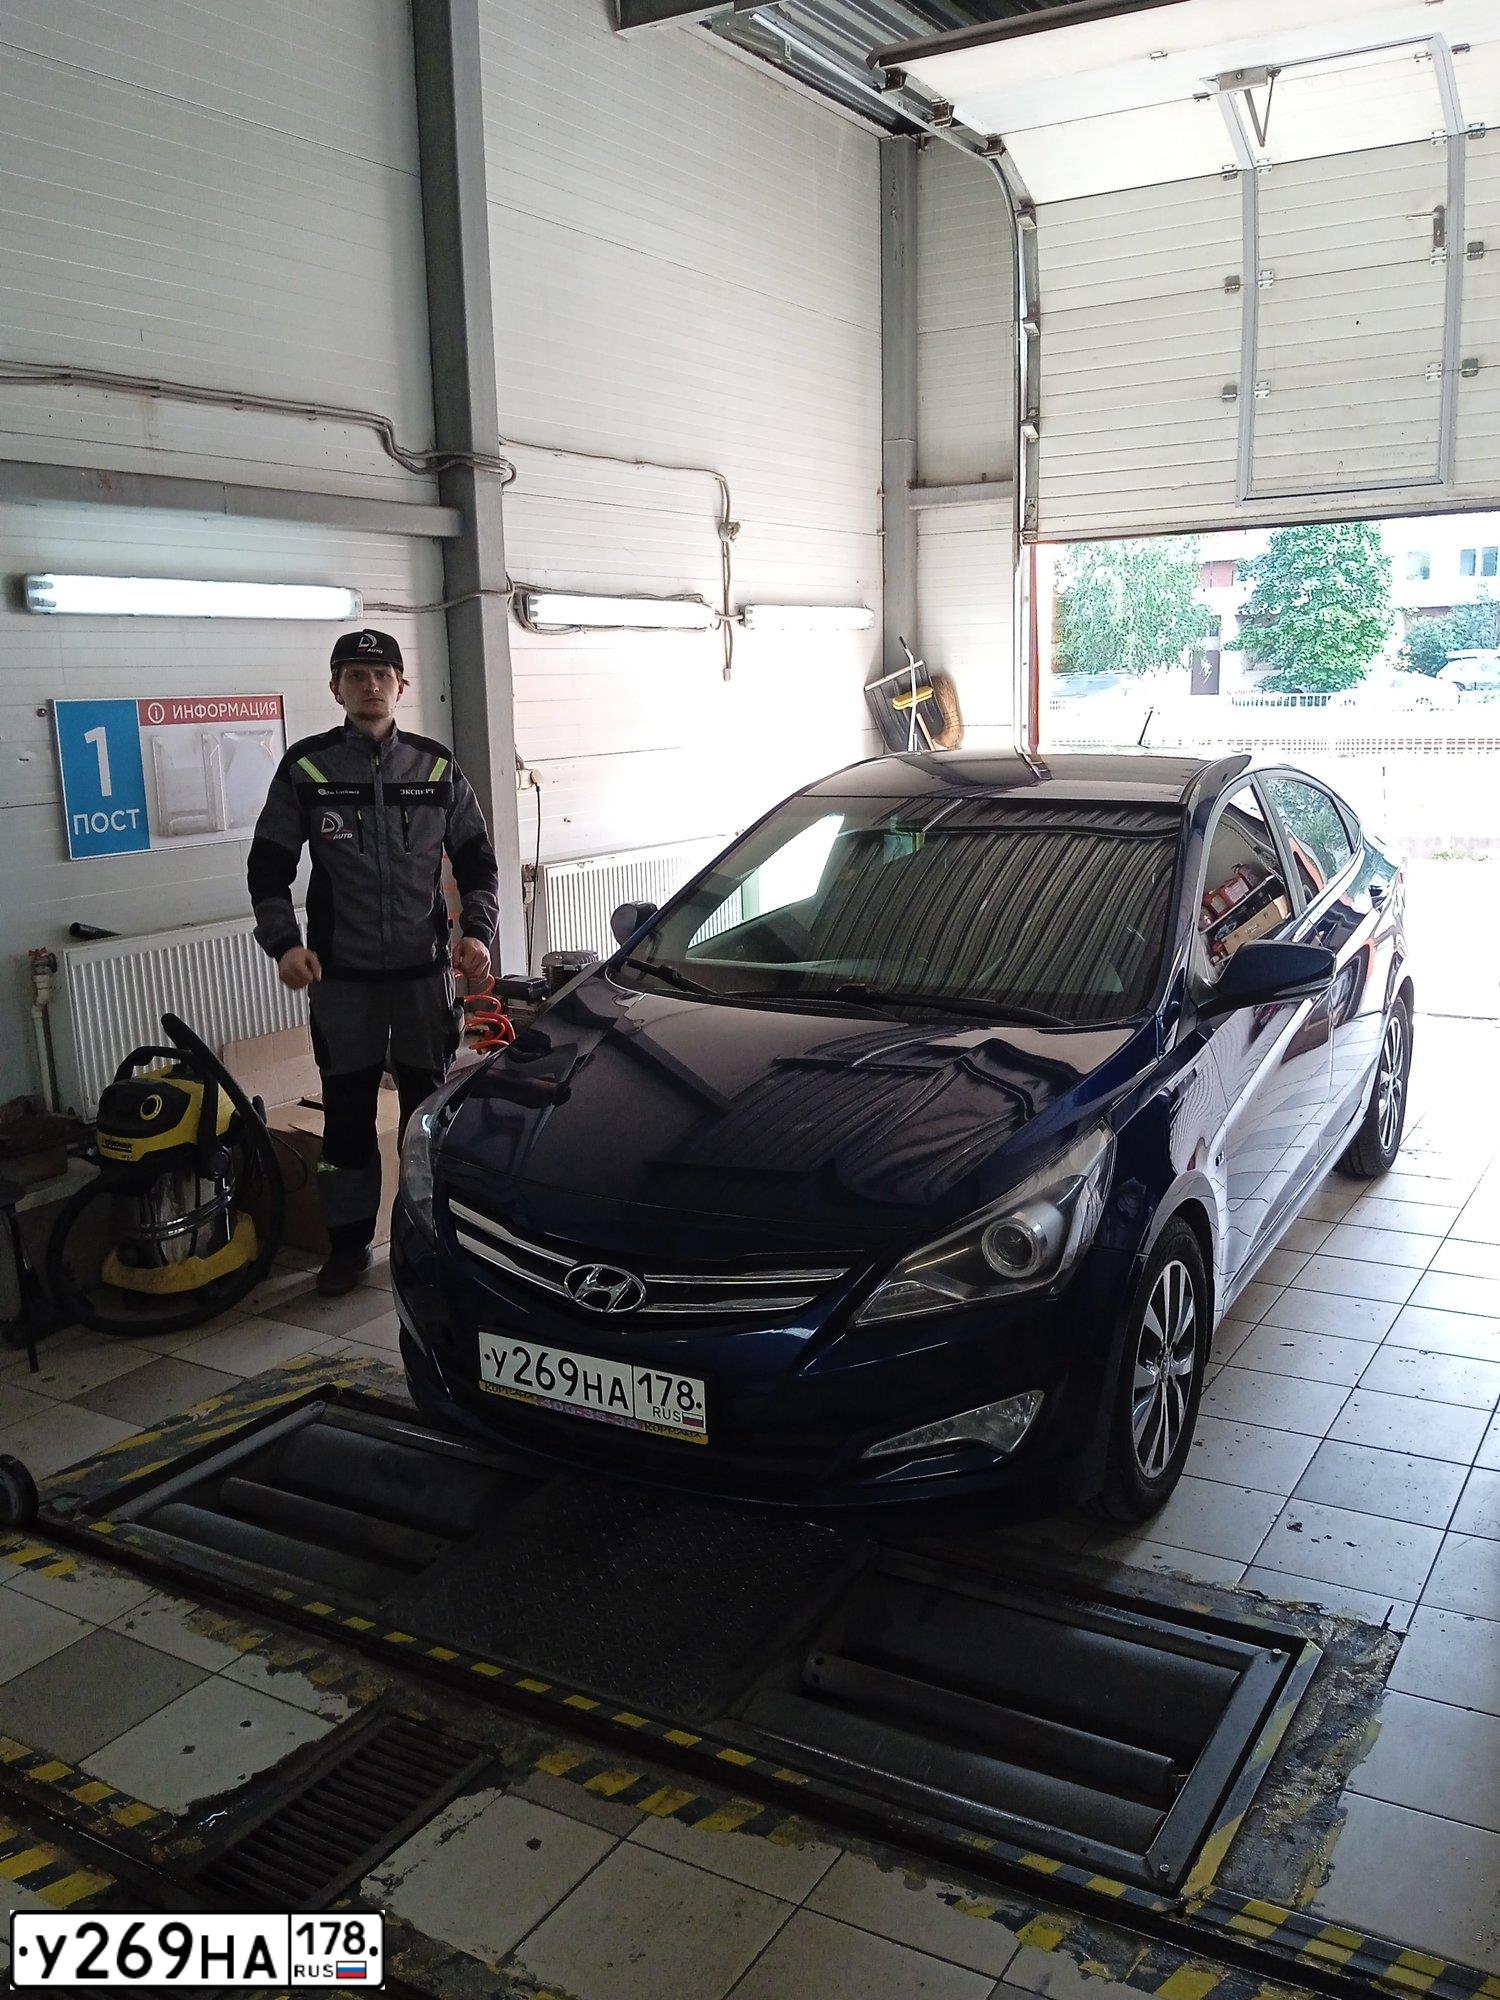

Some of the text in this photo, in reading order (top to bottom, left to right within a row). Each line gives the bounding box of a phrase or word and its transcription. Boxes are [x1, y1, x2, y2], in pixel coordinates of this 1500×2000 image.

[172, 701, 278, 719] ИНФОРМАЦИЯ
[83, 726, 112, 797] 1
[73, 808, 140, 835] ПОСТ
[491, 1346, 695, 1412] У269НА 178
[652, 1406, 682, 1423] RUS
